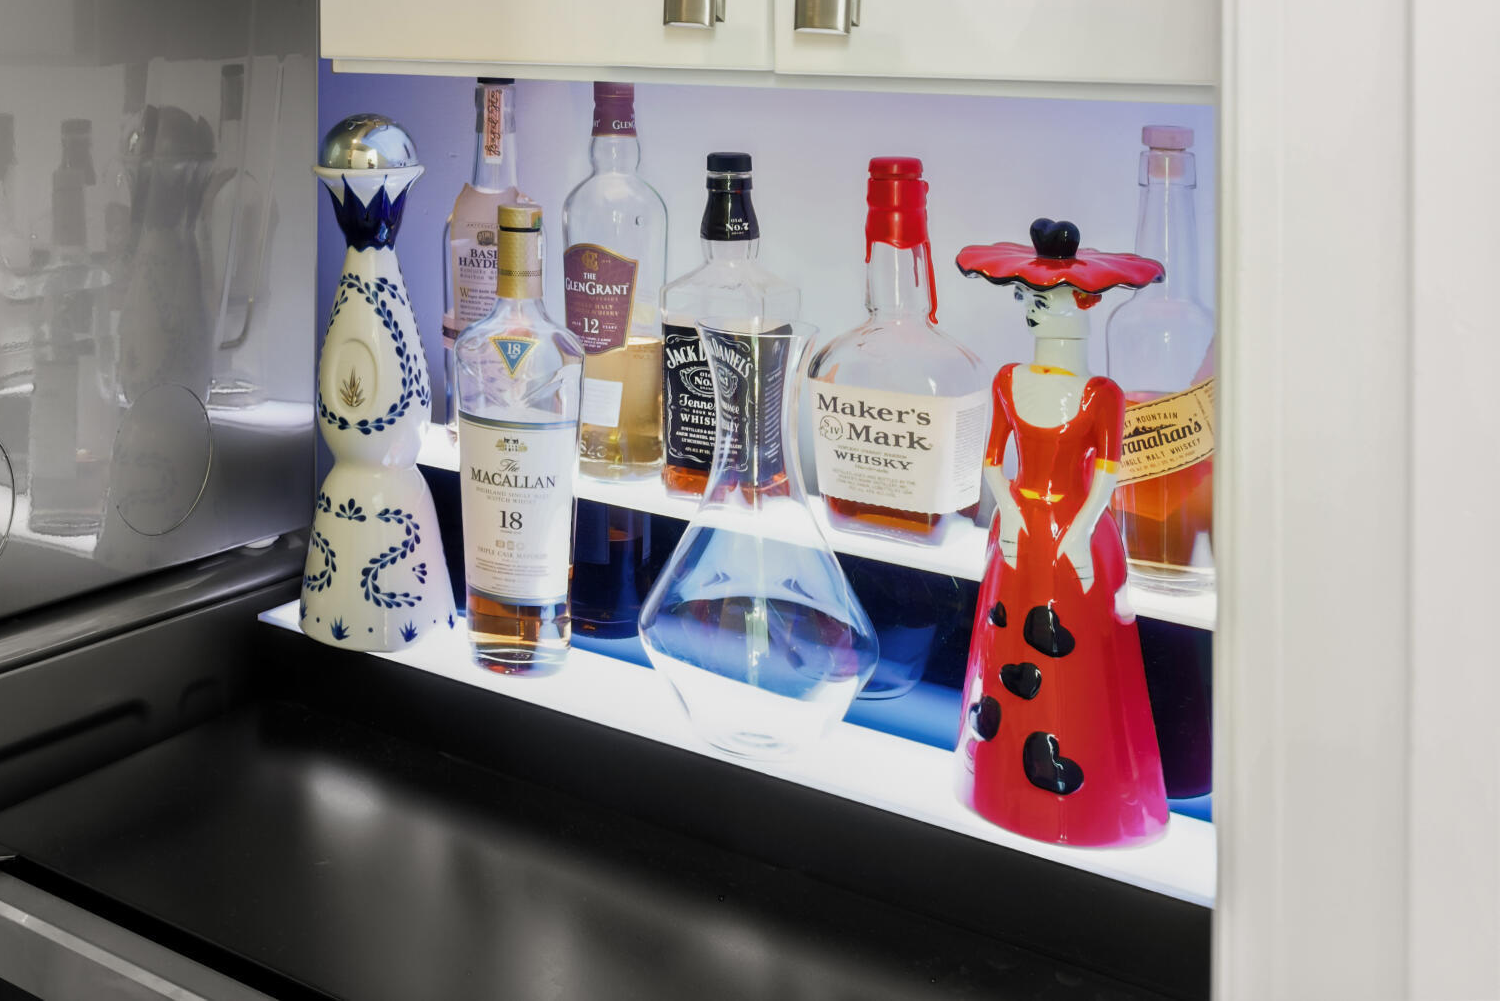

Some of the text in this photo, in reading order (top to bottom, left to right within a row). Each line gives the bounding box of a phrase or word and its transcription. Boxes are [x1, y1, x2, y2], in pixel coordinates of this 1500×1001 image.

[459, 257, 498, 269] HAYDE
[470, 249, 498, 259] BASI
[583, 272, 597, 280] THE
[583, 317, 599, 334] 12
[507, 343, 521, 355] 18
[666, 345, 698, 369] JACK
[816, 392, 931, 426] Maker's
[1136, 411, 1178, 424] MOUNTAIN
[846, 422, 931, 451] Mark
[1122, 417, 1202, 456] ranahan's
[833, 449, 914, 471] WHISKY
[1146, 451, 1165, 462] MALT
[1170, 438, 1201, 455] WHISKEY
[498, 459, 520, 472] The
[470, 466, 556, 489] MACALLAN
[499, 510, 523, 530] 18
